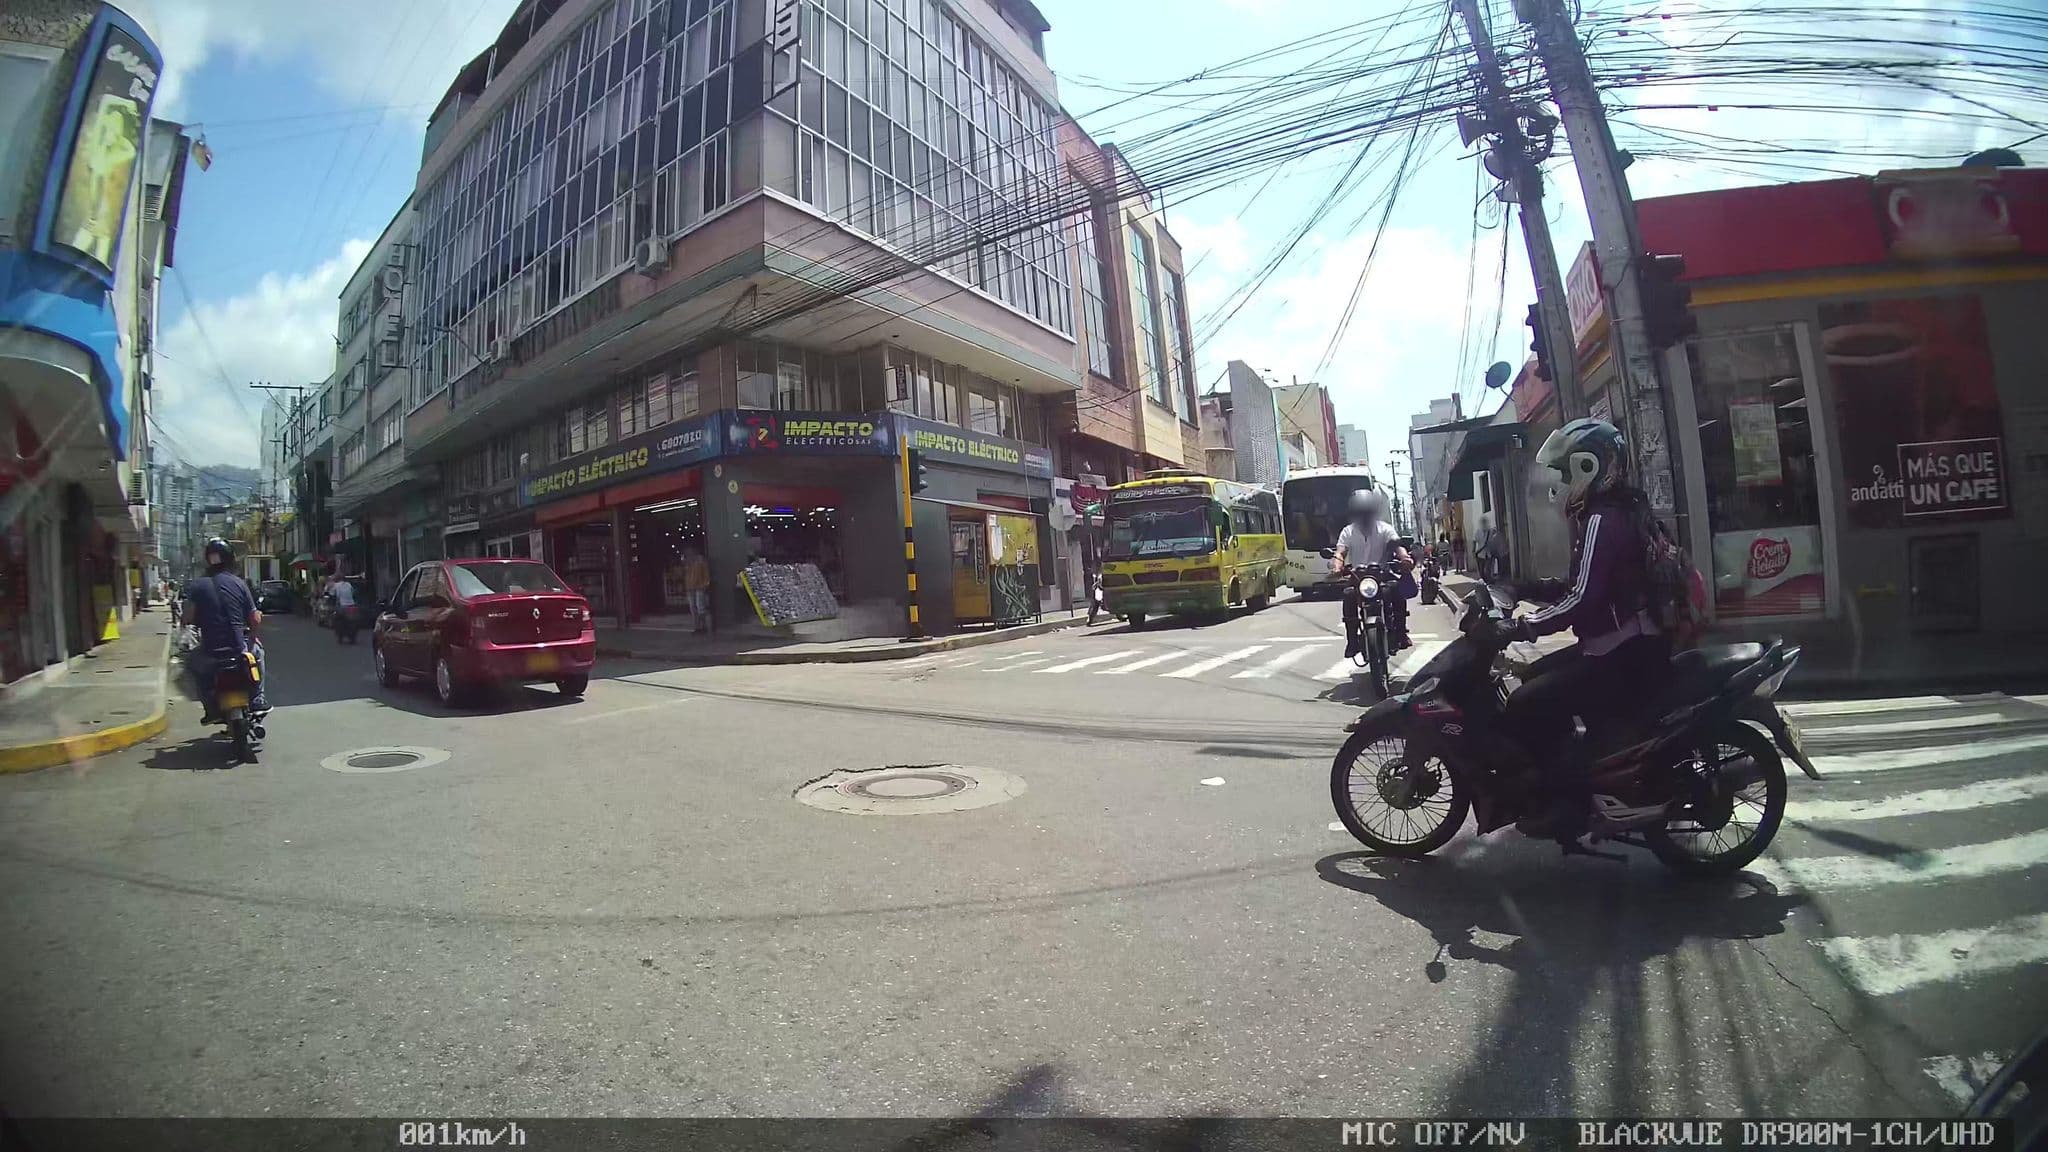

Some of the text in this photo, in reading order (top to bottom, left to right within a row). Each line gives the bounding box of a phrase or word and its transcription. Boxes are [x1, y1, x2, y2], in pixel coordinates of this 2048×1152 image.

[784, 421, 873, 436] IMPACTO
[786, 437, 854, 445] ELECTRICO
[915, 430, 965, 454] IMPACTO
[968, 439, 1019, 464] ELÉCTRICO
[578, 447, 649, 484] ELÉCTRICO
[1907, 451, 1994, 479] MÁS QUE
[1851, 479, 1905, 501] andatti
[1910, 473, 1999, 505] UN CAFÉ
